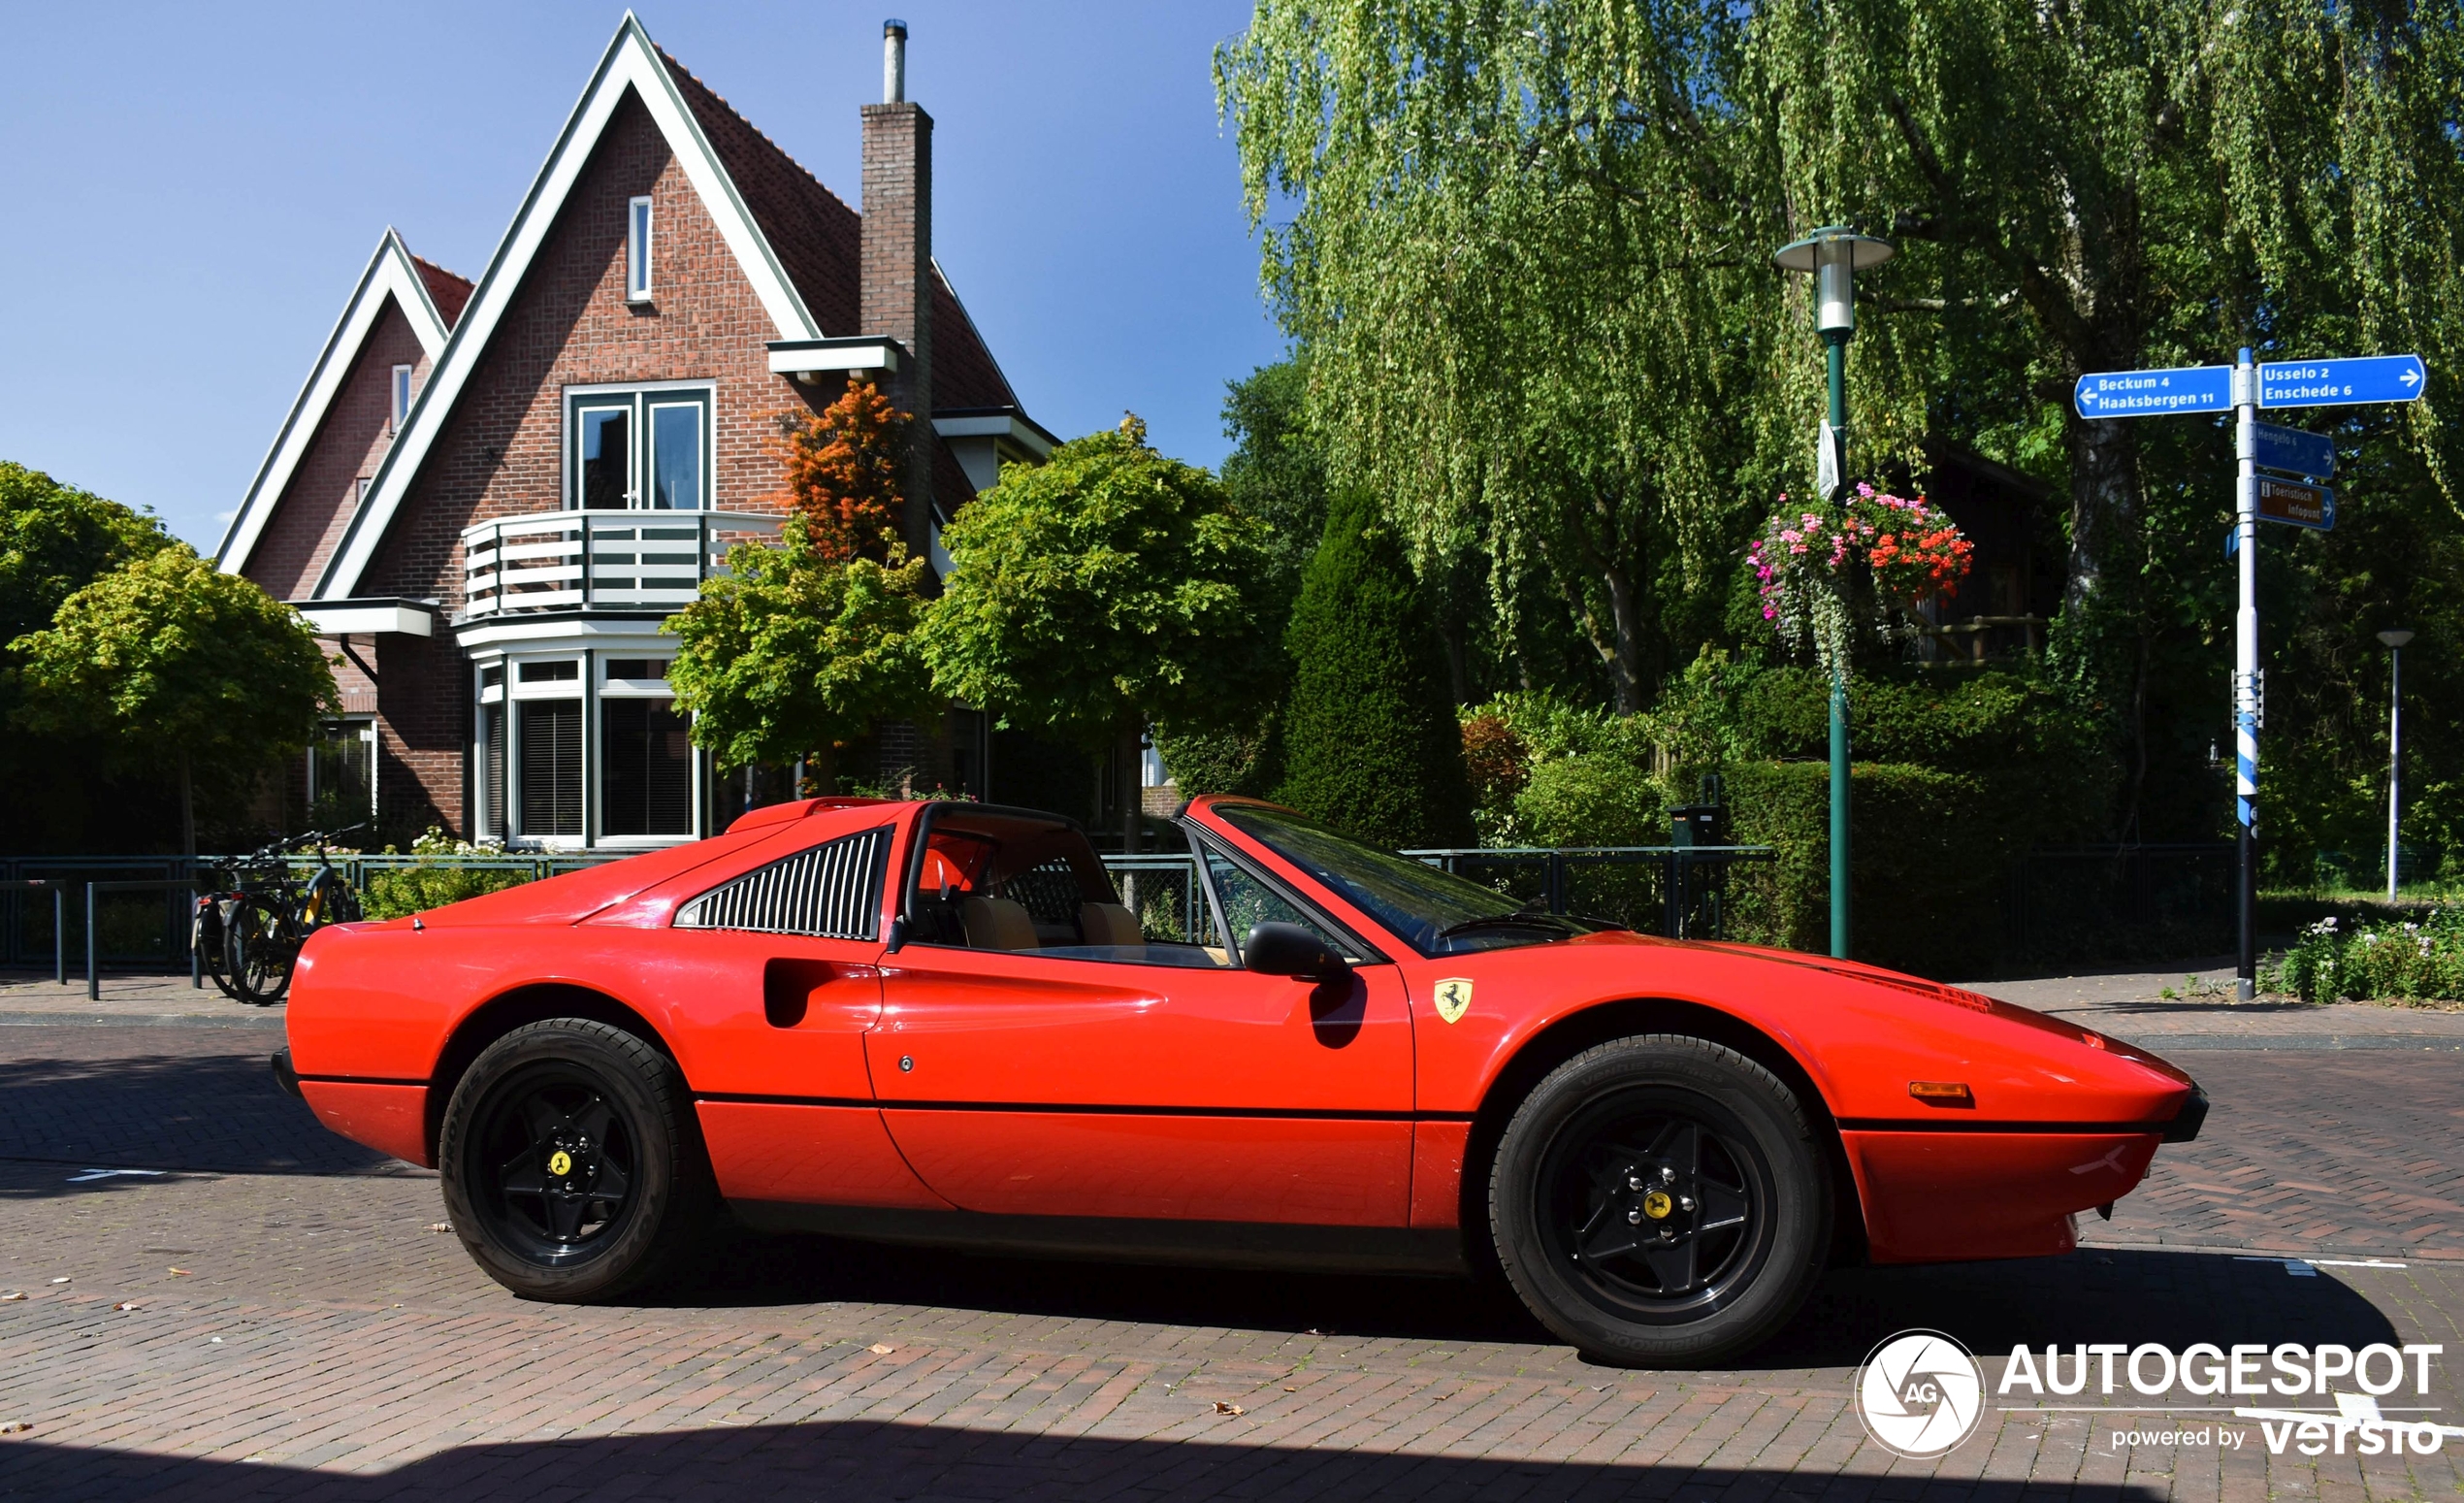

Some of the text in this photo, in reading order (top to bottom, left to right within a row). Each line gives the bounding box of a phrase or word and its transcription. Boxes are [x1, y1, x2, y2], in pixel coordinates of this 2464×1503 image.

[2265, 367, 2329, 381] Usselo 2
[2098, 376, 2170, 391] Beckum 4
[2265, 384, 2352, 400] Enschede 6
[2098, 393, 2214, 409] Haaksbergen 11
[2257, 428, 2290, 445] Hengelo
[2271, 484, 2313, 502] Toeristisch
[2287, 505, 2320, 519] Infopunt
